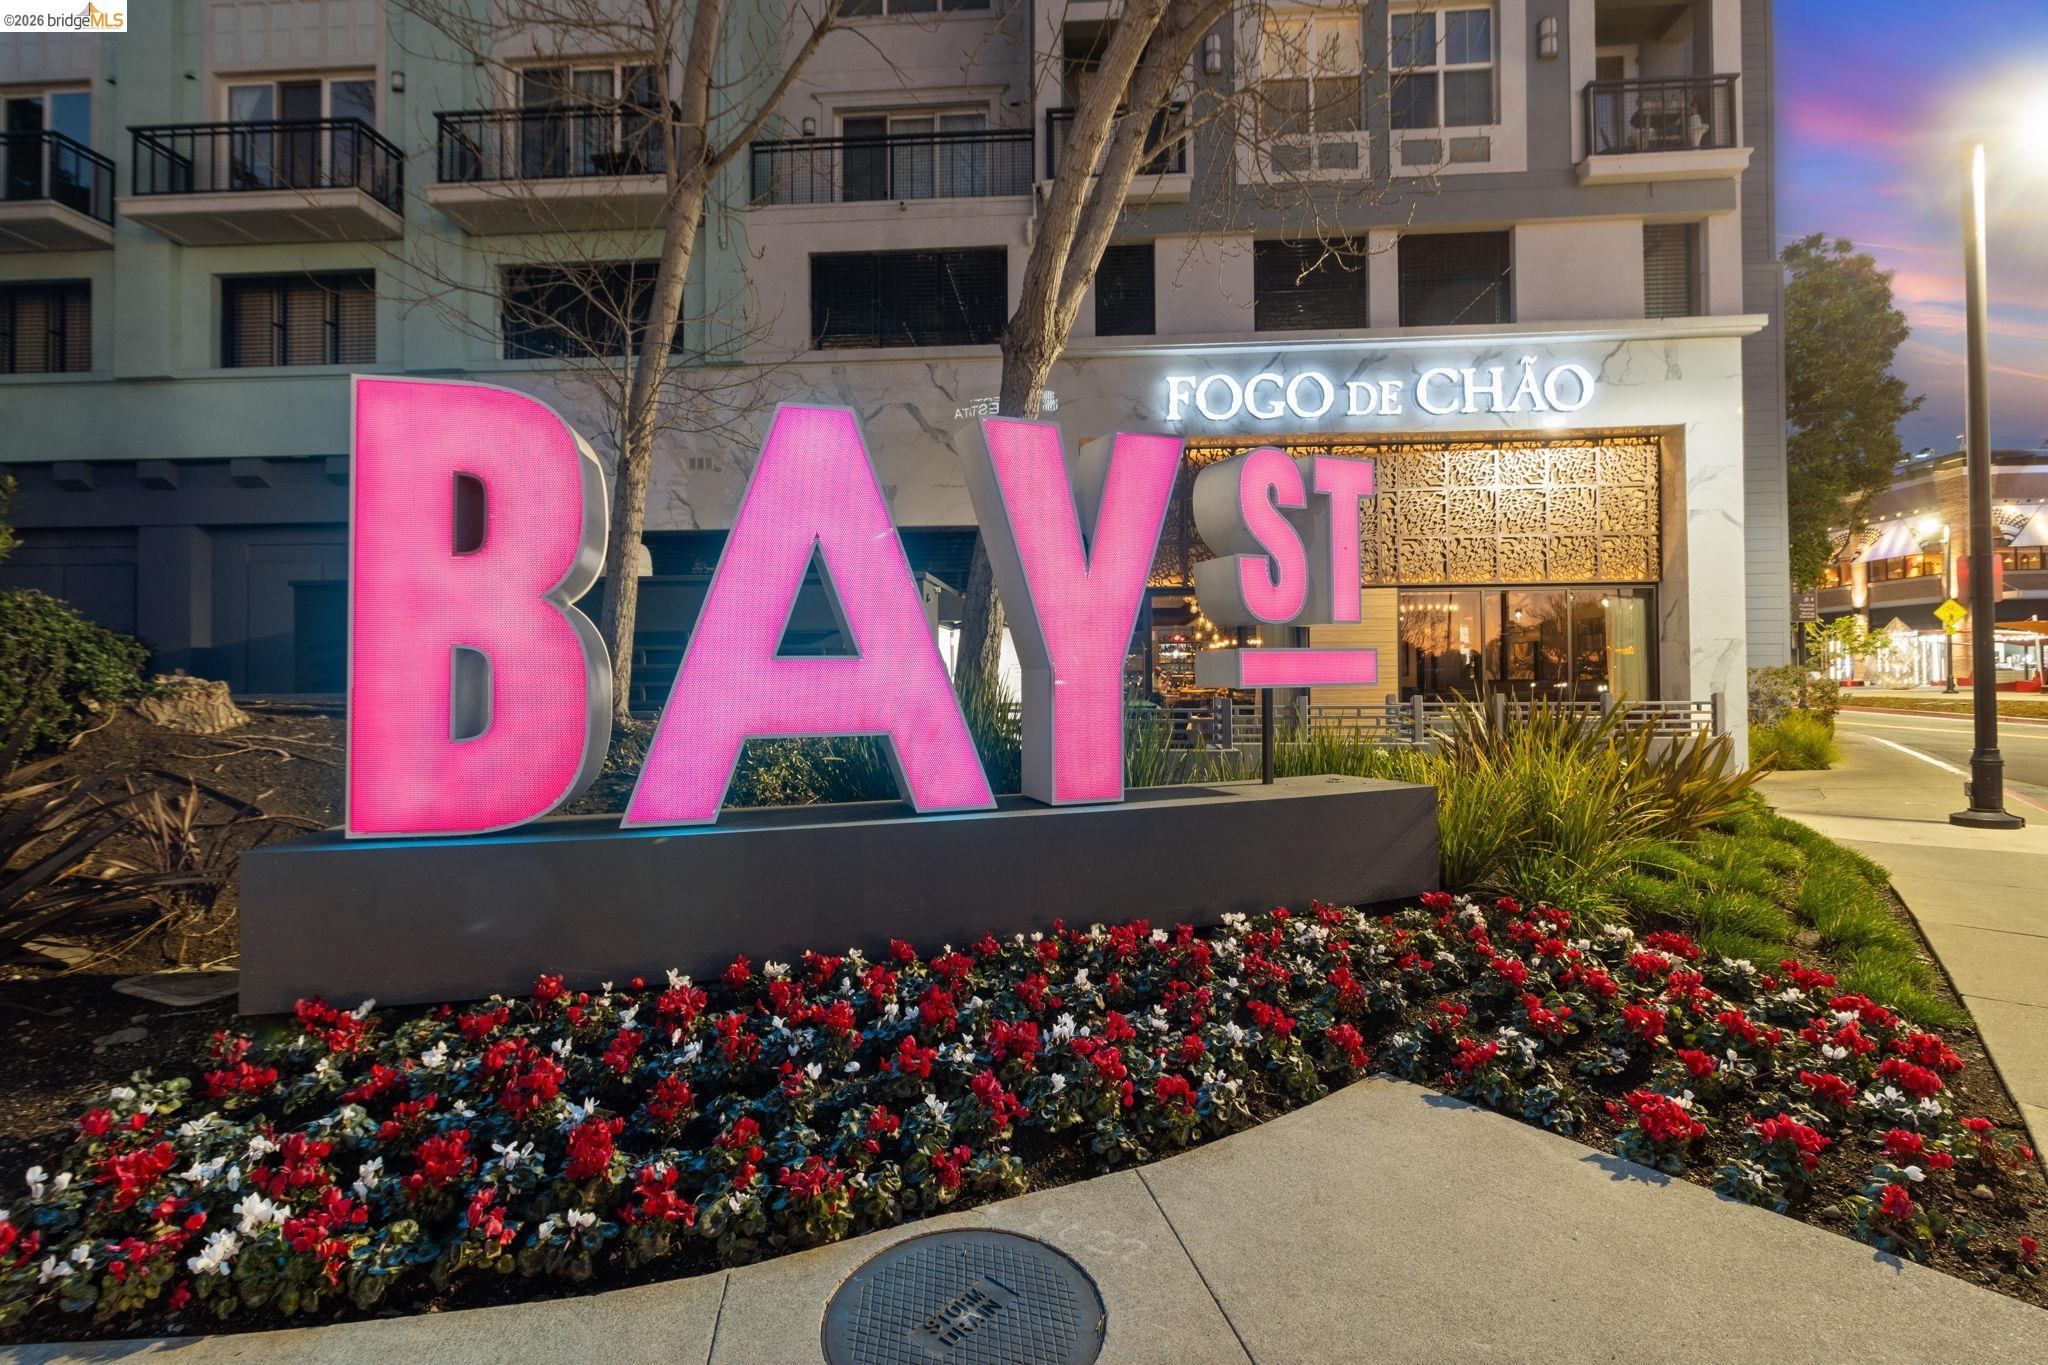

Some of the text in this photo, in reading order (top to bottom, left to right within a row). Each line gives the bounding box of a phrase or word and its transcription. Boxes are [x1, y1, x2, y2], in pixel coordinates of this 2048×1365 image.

[1166, 355, 1596, 421] FOGO DE CHÃO
[345, 373, 1376, 840] BAY ST
[923, 1287, 987, 1335] STORM
[937, 1298, 1004, 1347] DRAIN
